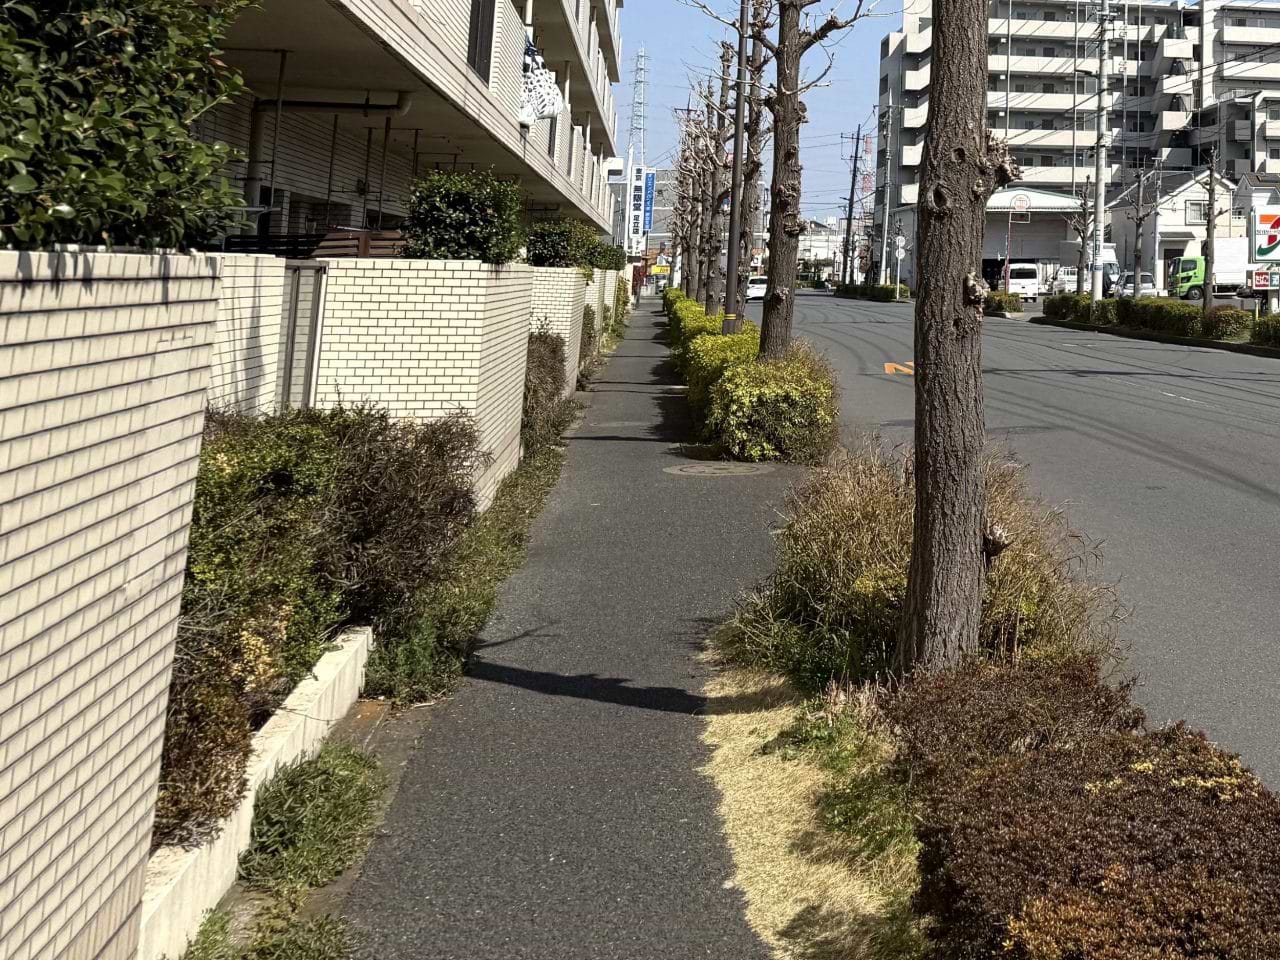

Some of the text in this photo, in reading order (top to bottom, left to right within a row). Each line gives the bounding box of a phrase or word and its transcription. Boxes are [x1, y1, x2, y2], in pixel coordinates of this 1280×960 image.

[636, 168, 642, 181] 東京
[633, 186, 642, 211] 無限堂
[632, 215, 640, 234] 足立店
